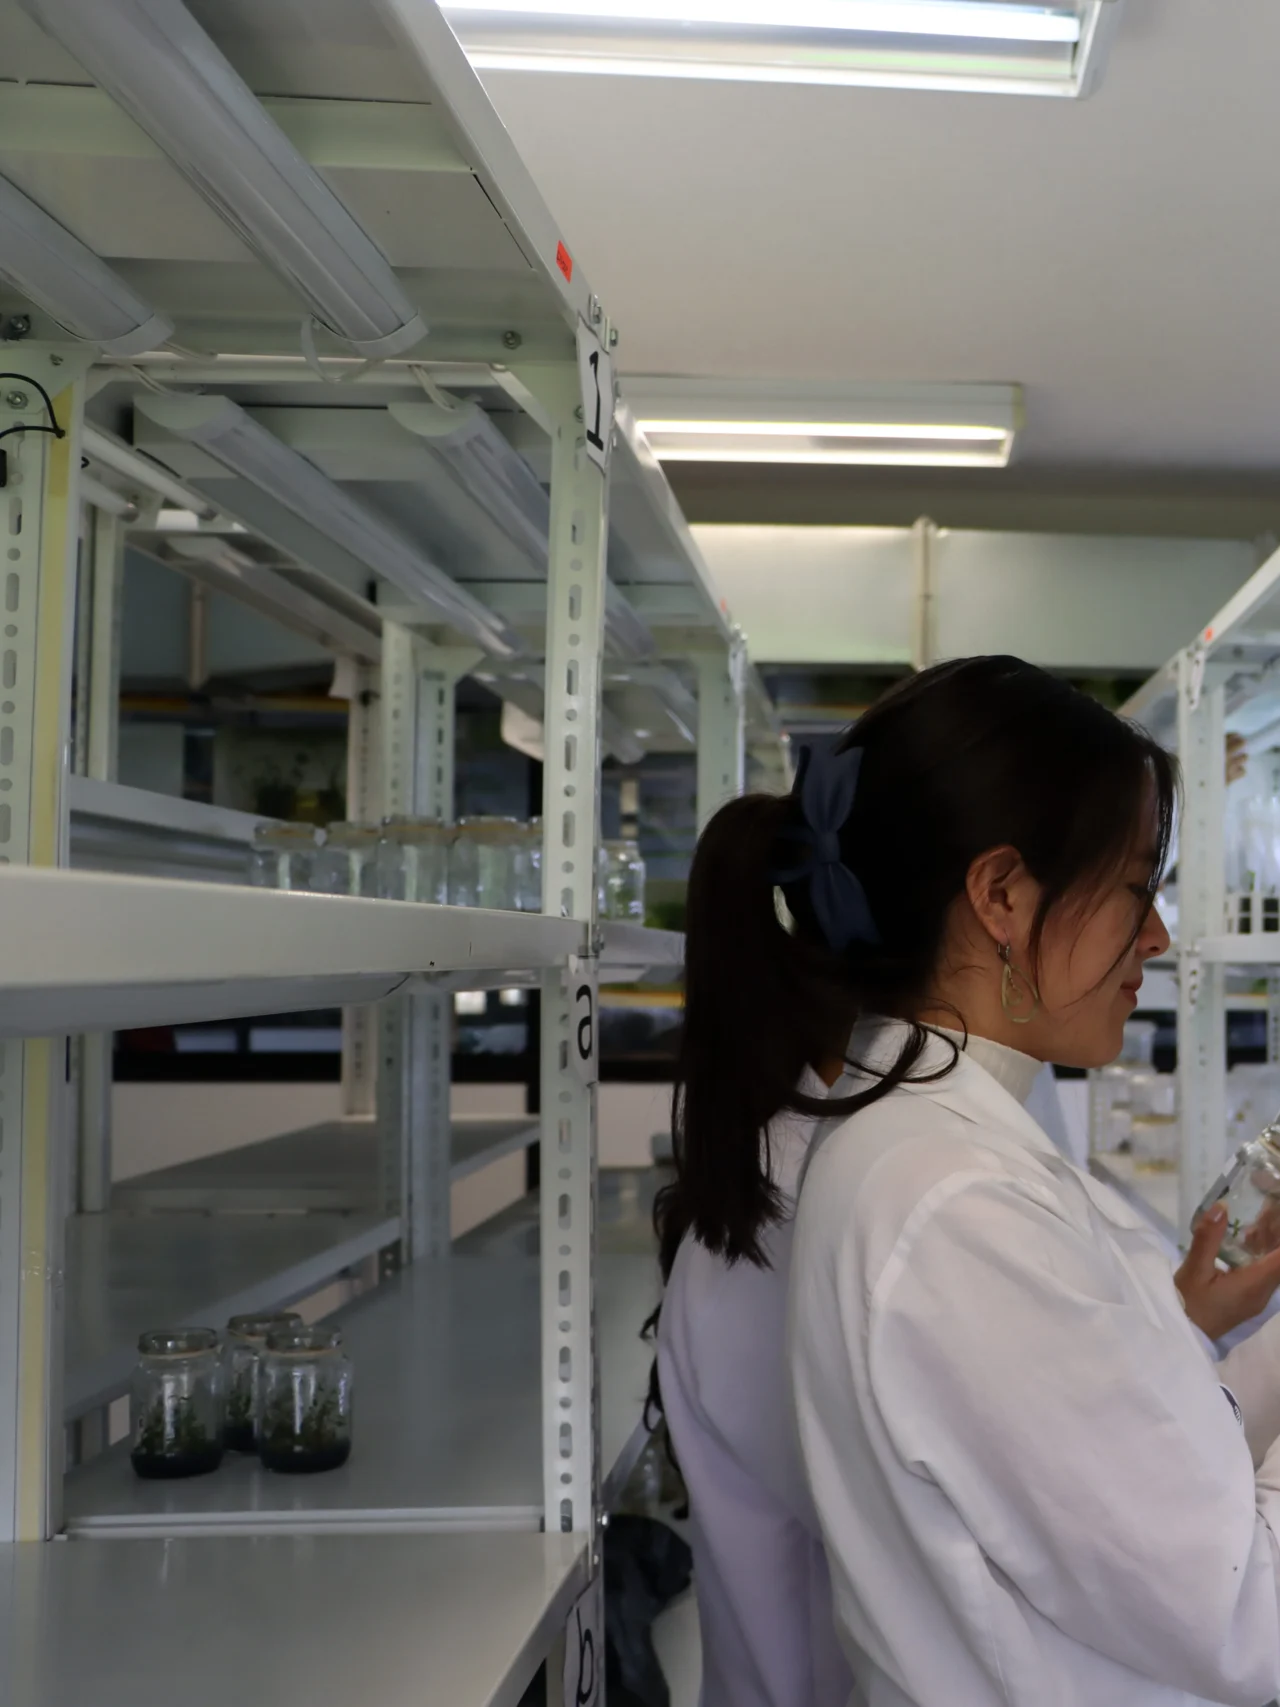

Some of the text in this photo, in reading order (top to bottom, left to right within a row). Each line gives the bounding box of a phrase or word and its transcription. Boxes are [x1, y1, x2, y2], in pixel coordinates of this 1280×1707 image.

[586, 350, 604, 452] 1
[575, 984, 593, 1061] a
[575, 1606, 595, 1707] b
